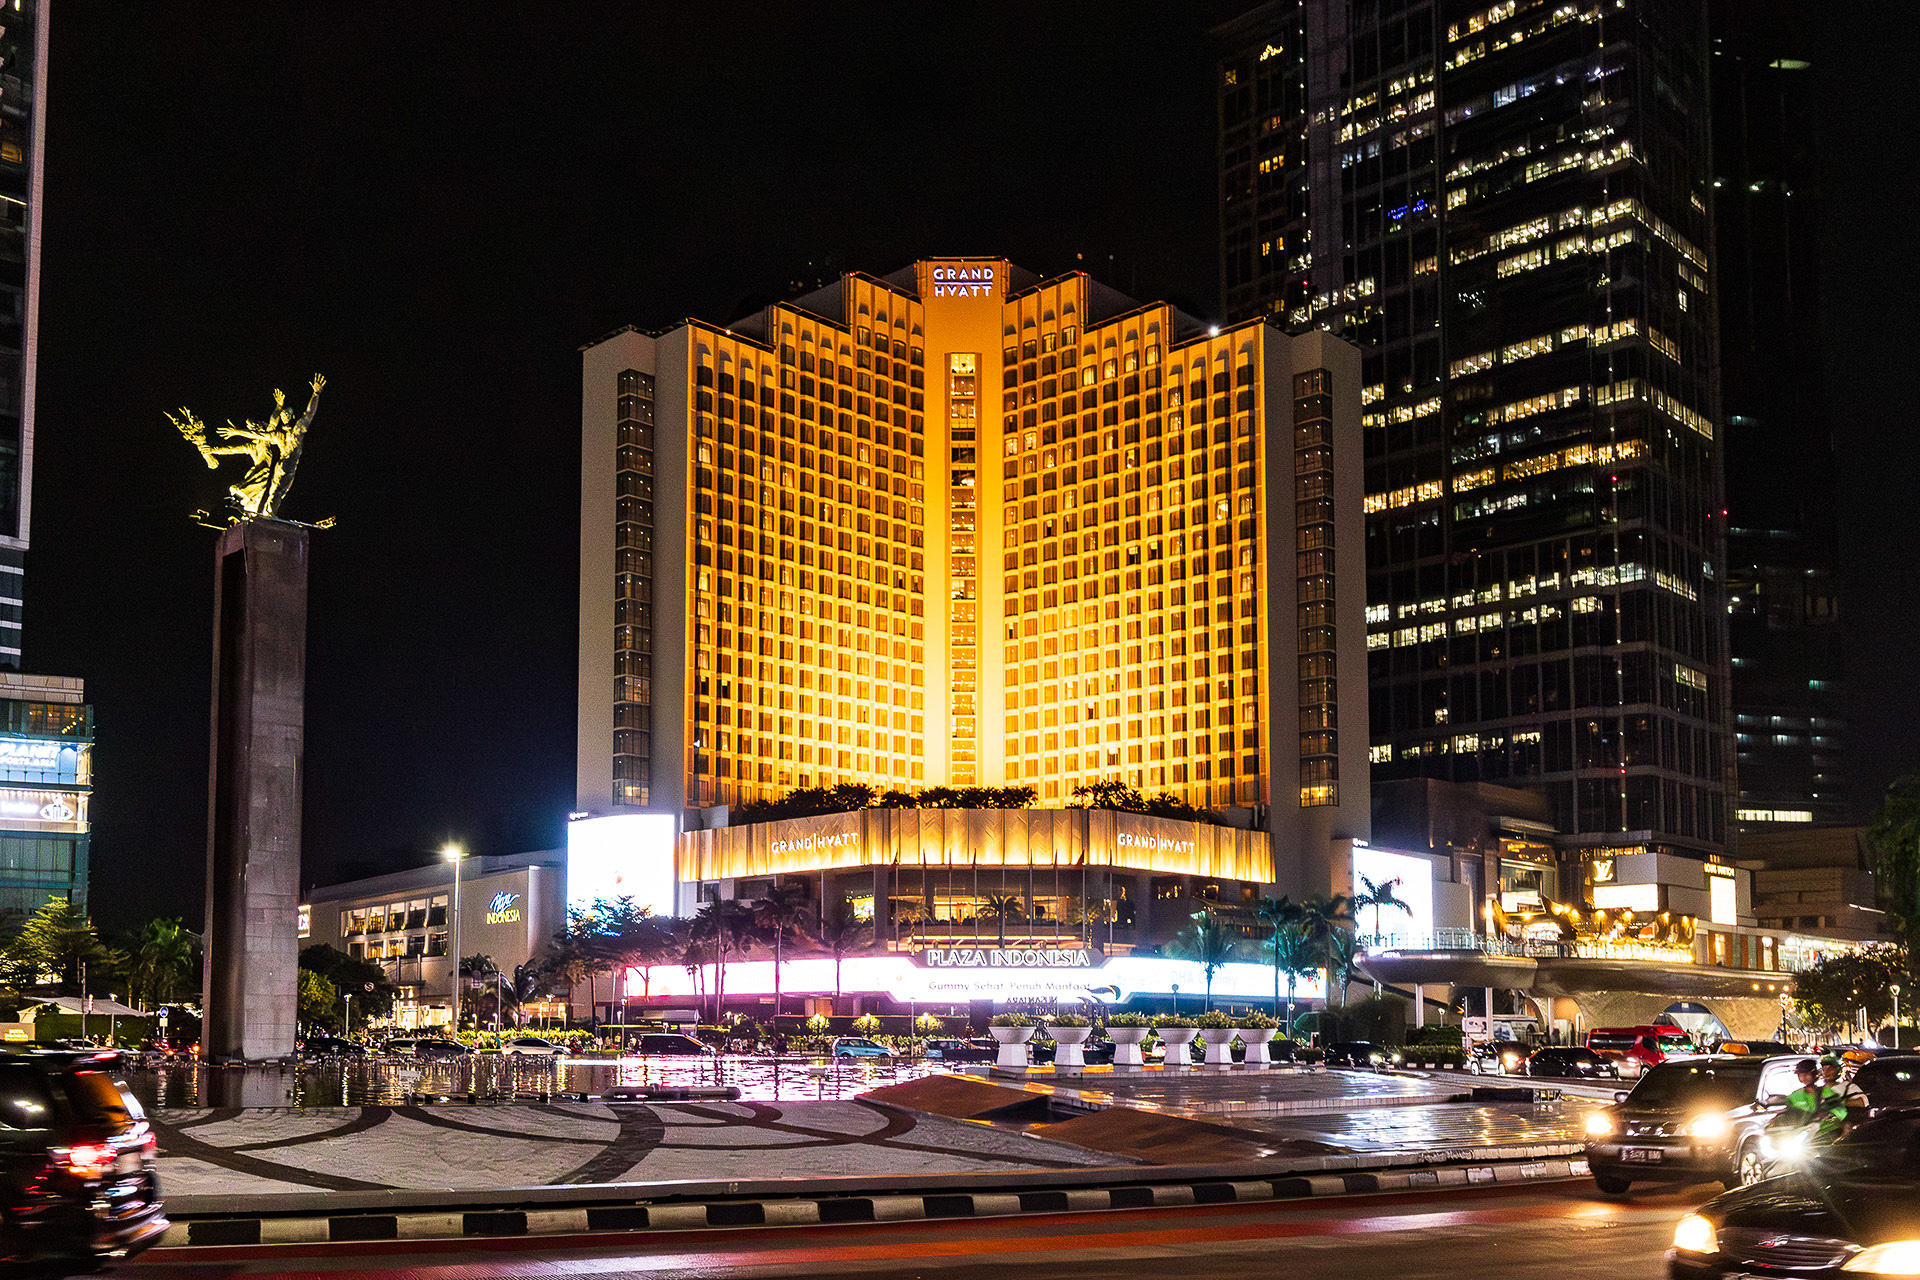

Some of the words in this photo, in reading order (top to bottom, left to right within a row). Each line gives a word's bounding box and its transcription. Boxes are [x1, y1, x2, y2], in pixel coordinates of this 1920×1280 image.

[933, 268, 994, 280] GRAND
[934, 286, 992, 297] HYATT
[771, 838, 813, 854] GRAND
[817, 832, 859, 849] HYATT
[1117, 833, 1157, 850] GRAND
[1160, 838, 1195, 855] HYATT
[486, 909, 521, 924] INDONESIA
[928, 950, 988, 967] PLAZA
[990, 950, 1090, 967] INDONESIA
[928, 981, 970, 991] Gummy
[974, 981, 1004, 991] Sehat
[1010, 981, 1042, 991] Penuh
[1171, 970, 1194, 984] DHA
[1200, 971, 1237, 987] Gmmy
